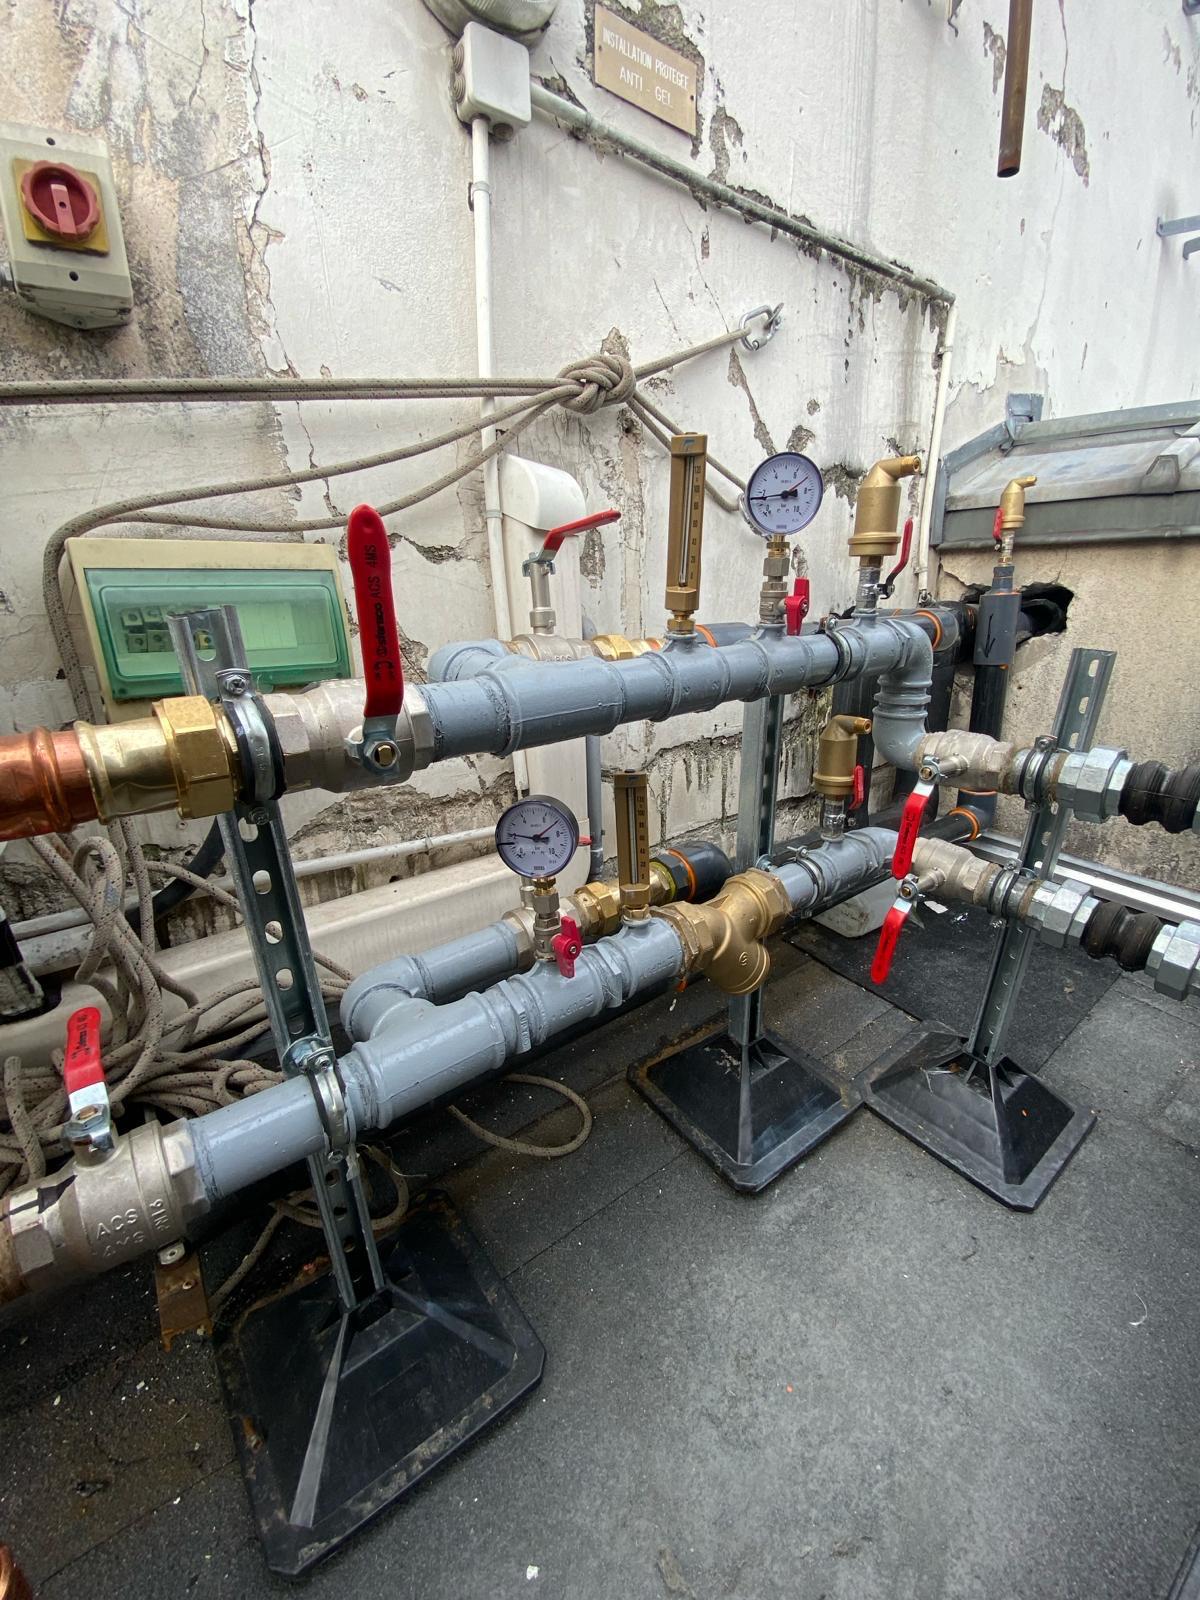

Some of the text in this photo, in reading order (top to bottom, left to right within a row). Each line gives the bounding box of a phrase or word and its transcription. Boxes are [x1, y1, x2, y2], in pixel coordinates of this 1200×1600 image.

[602, 27, 652, 70] INSTALLATION
[619, 66, 643, 92] ANTI
[364, 544, 377, 567] 4MS
[368, 575, 381, 601] ACS
[96, 1208, 139, 1240] ACS
